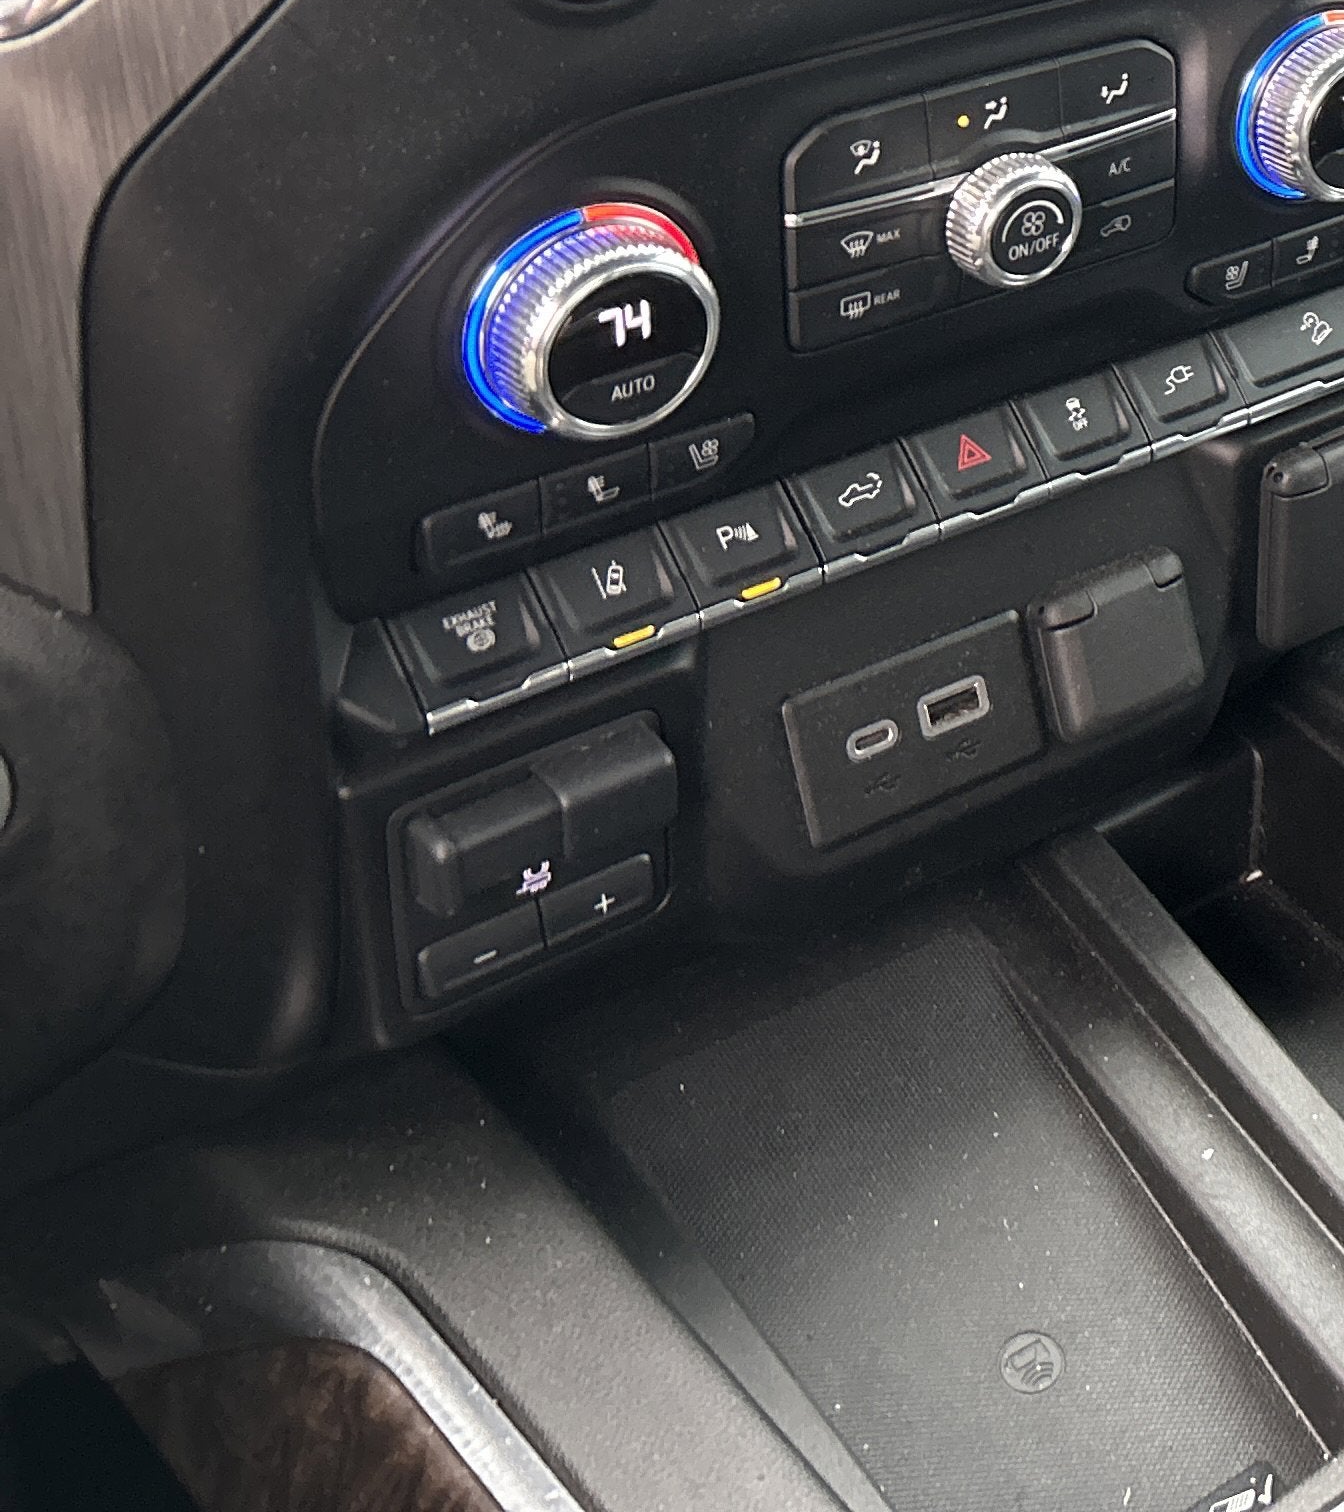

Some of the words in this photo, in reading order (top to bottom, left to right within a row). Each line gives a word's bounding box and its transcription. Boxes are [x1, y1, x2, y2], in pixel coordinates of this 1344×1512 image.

[1107, 157, 1131, 177] A/C
[876, 228, 901, 244] MAX
[1007, 232, 1060, 261] ON/OFF
[873, 289, 901, 306] REAR
[598, 298, 652, 347] 74
[611, 374, 656, 402] AUTO
